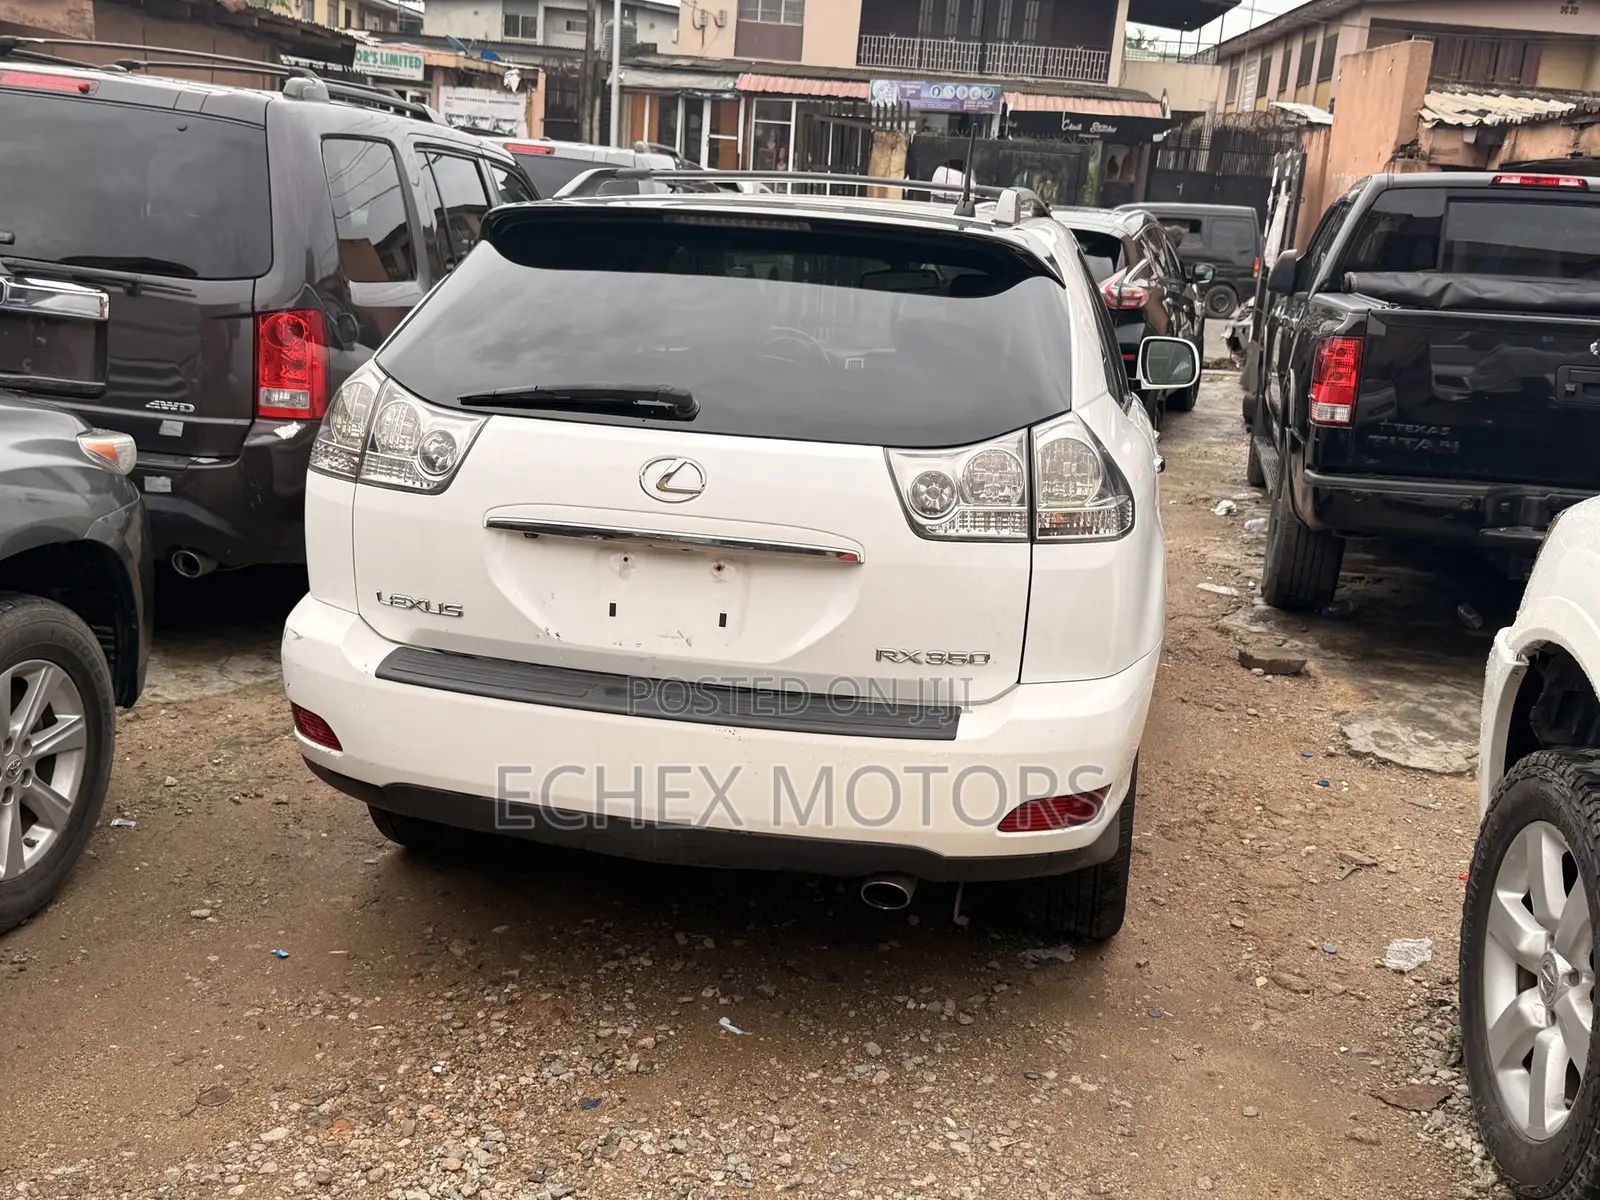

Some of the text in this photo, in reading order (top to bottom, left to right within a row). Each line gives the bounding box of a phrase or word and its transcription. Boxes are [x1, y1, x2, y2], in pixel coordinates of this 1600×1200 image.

[380, 52, 422, 69] LIMITED
[1394, 423, 1452, 435] TEXAS
[376, 589, 464, 618] LEXUS
[875, 647, 991, 666] RX 350
